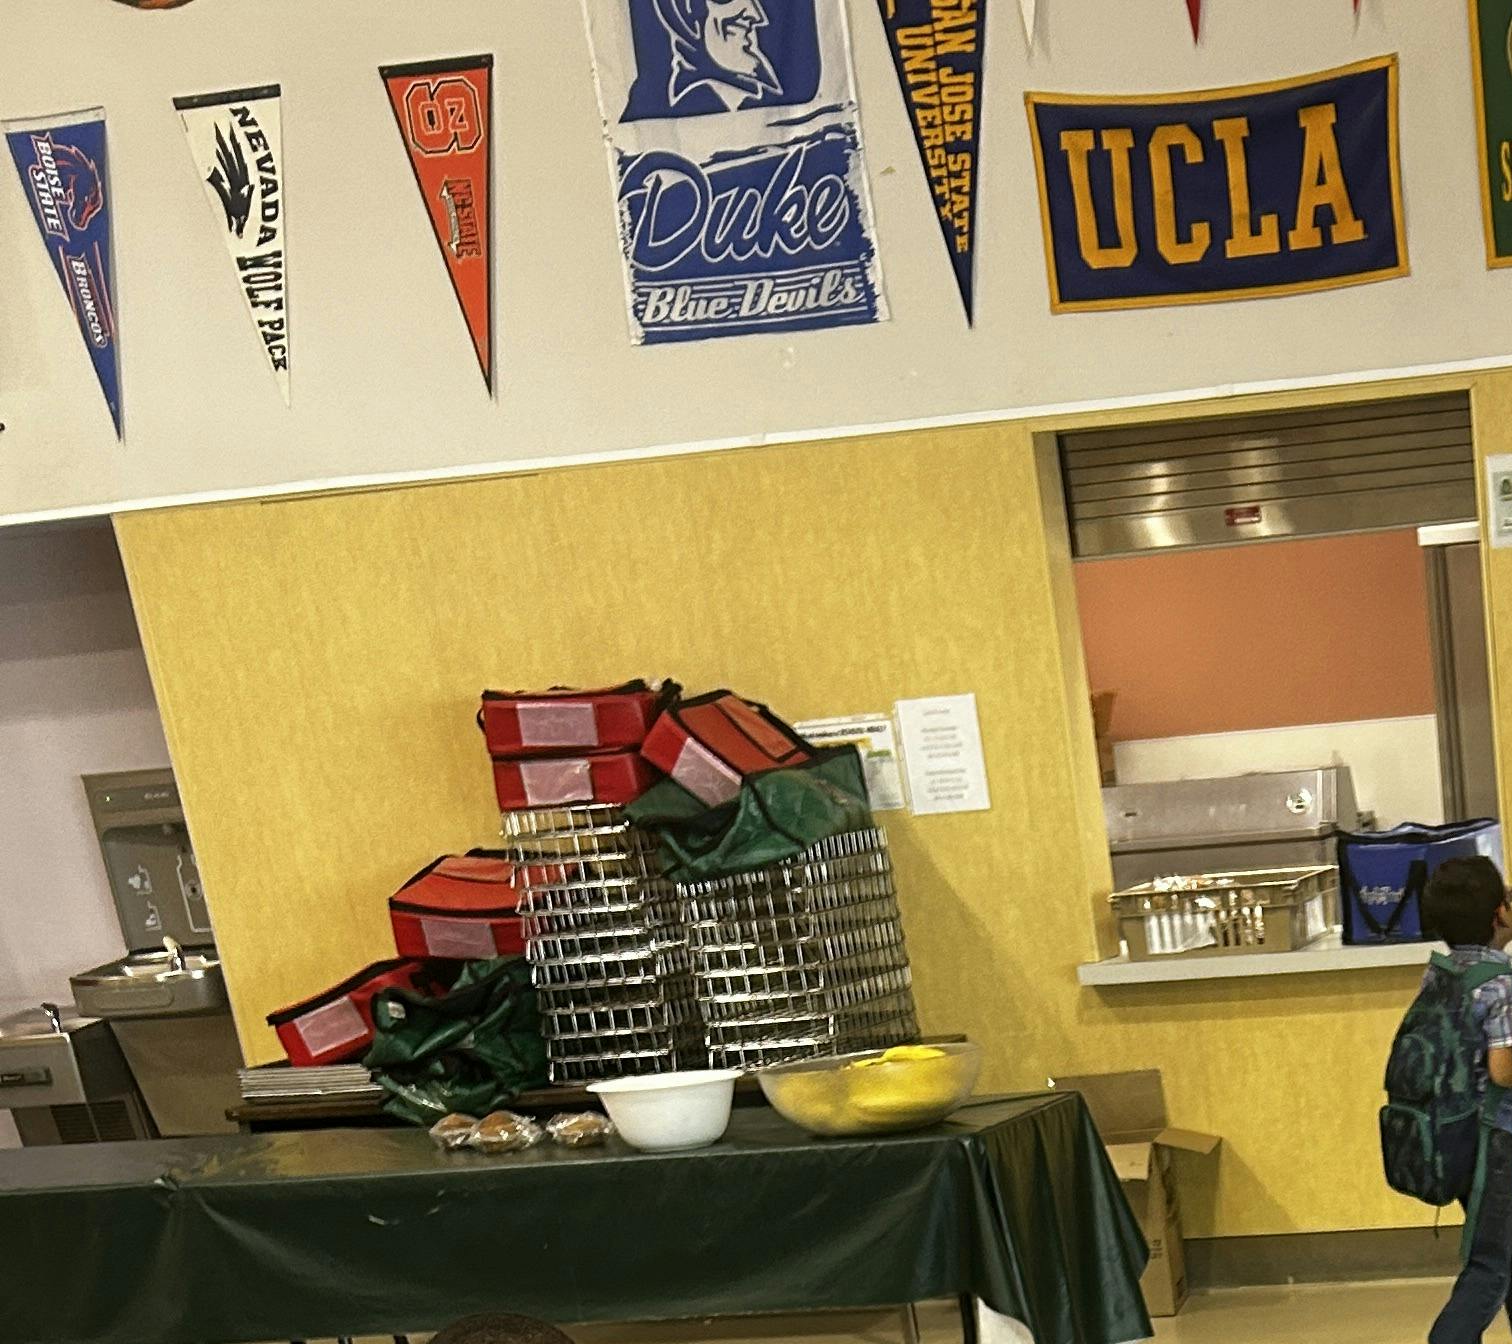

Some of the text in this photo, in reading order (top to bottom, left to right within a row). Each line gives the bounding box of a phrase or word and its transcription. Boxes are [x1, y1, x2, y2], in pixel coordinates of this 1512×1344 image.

[896, 24, 954, 220] UNIVERSITY
[938, 67, 975, 141] JOSE
[32, 167, 62, 234] STATE
[36, 140, 65, 201] BOISE
[617, 141, 850, 272] Duke
[948, 152, 971, 253] STATE
[1060, 103, 1368, 271] UCLA
[229, 106, 287, 372] NEVADA WOLF PACK
[641, 269, 866, 324] Blue Devils
